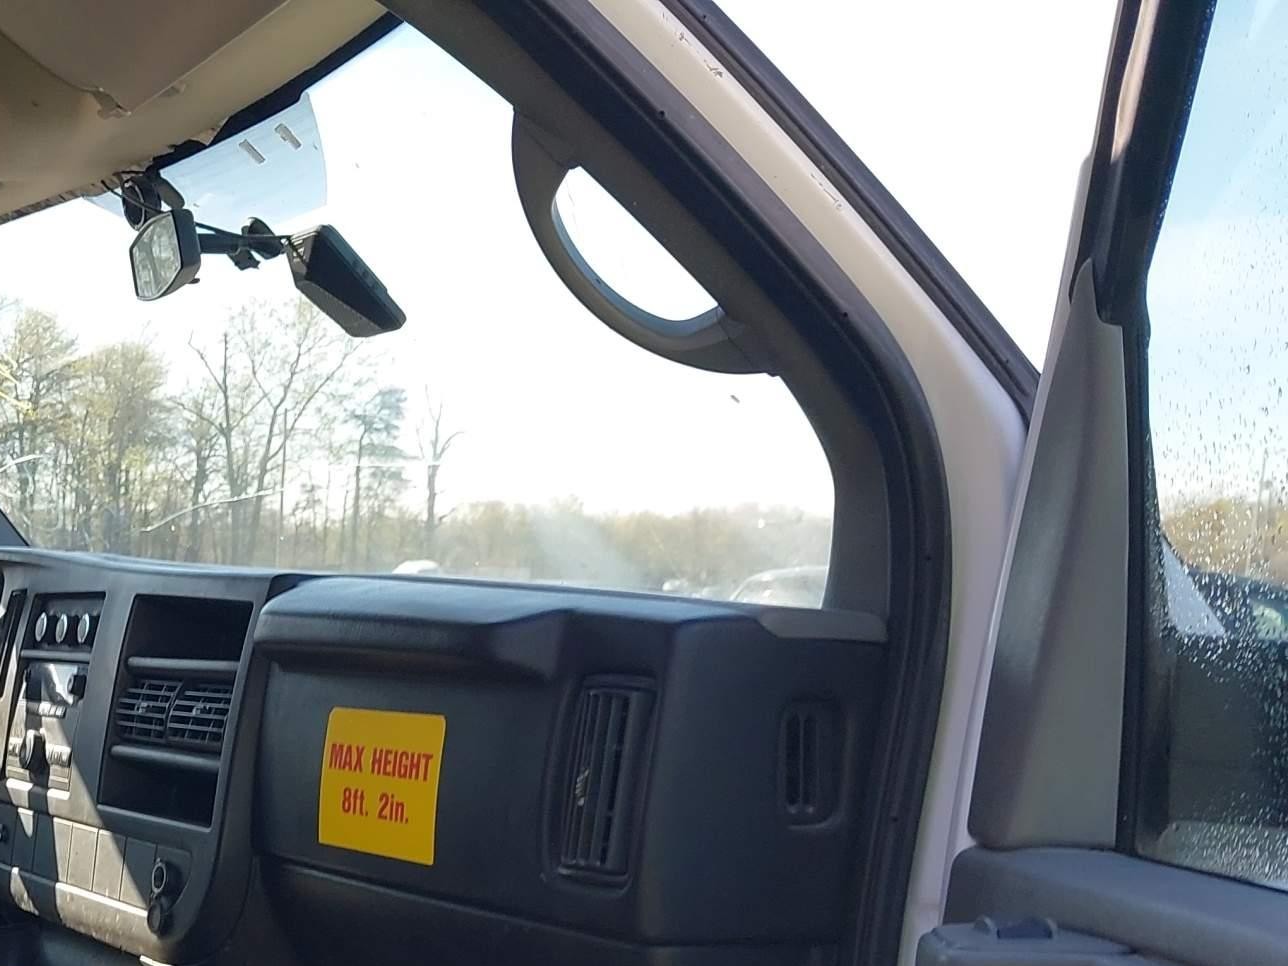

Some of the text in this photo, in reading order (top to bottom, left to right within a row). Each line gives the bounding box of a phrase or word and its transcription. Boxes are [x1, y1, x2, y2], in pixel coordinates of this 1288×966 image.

[329, 743, 433, 782] MAX HEIGHT
[342, 787, 409, 824] 8ft. 2in.
